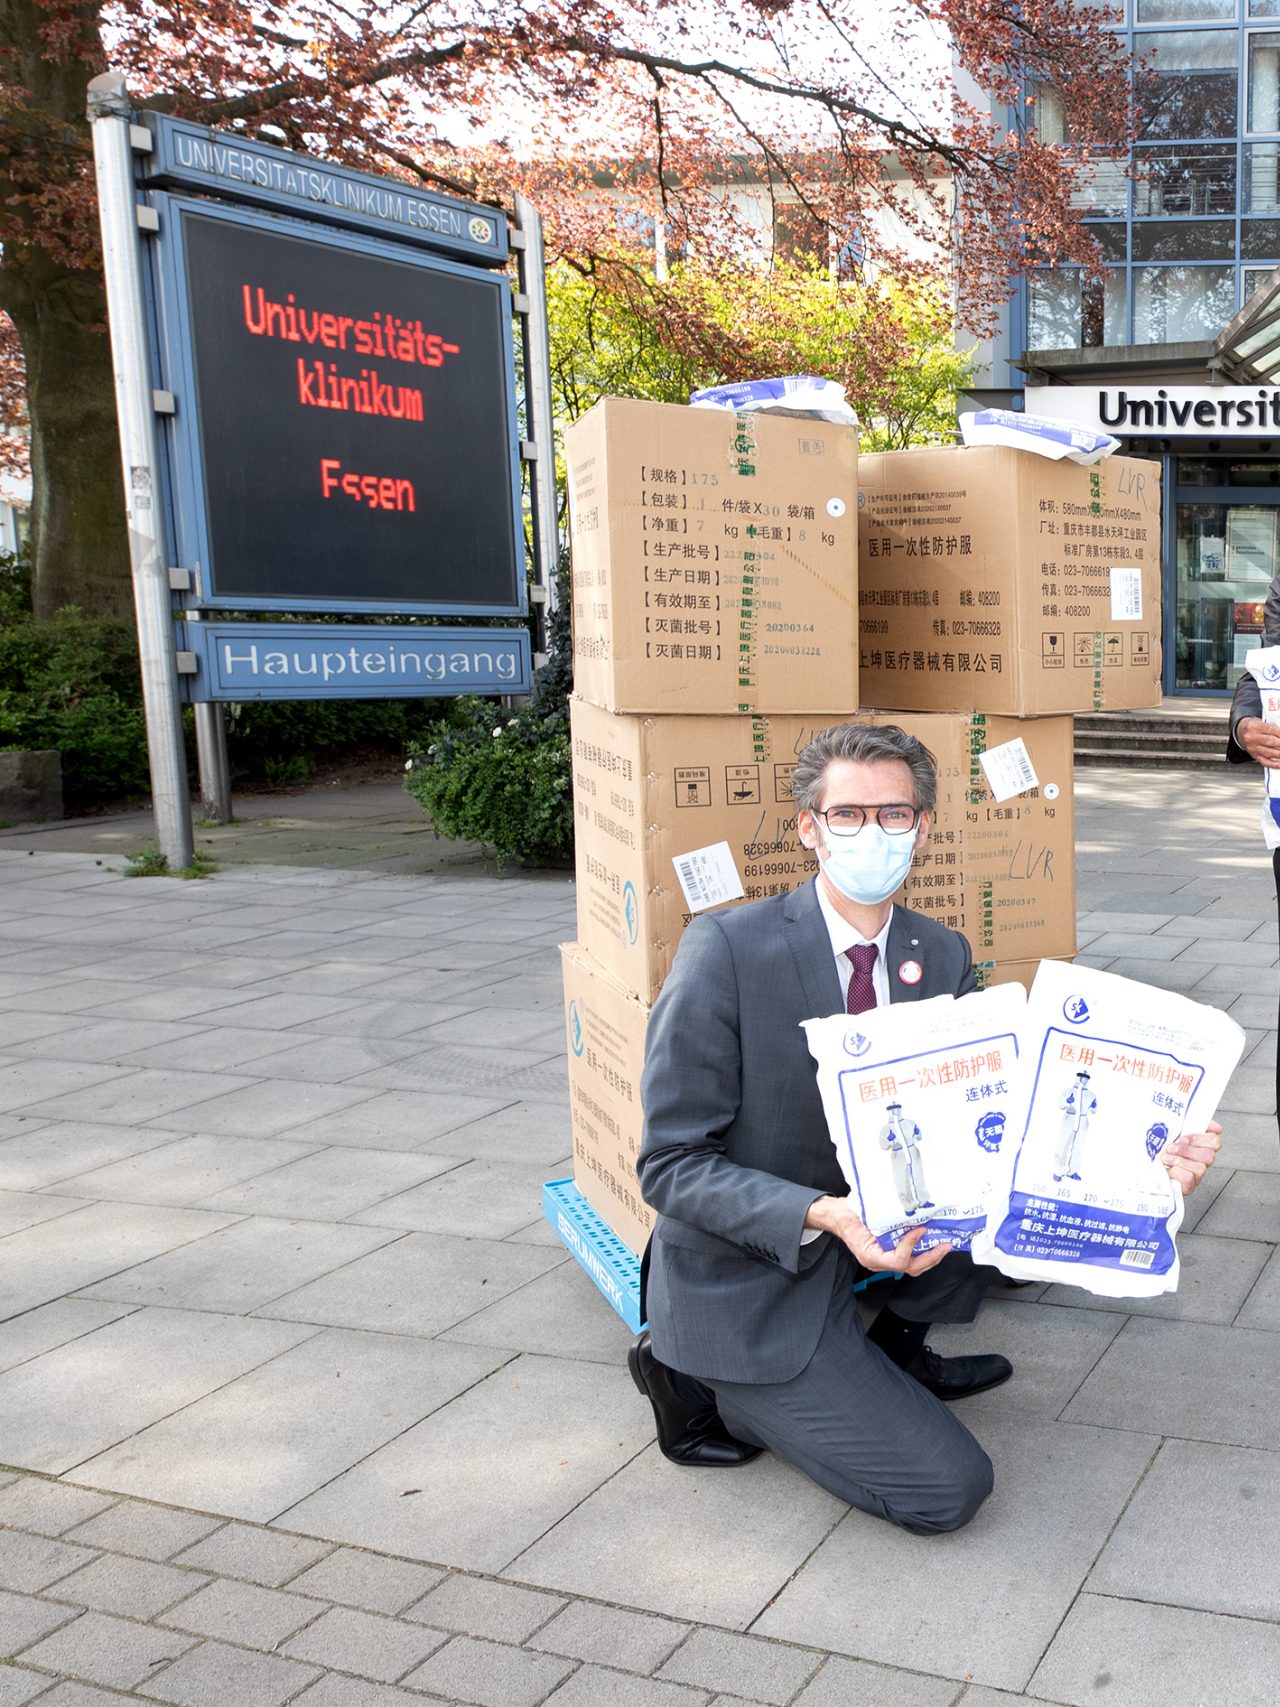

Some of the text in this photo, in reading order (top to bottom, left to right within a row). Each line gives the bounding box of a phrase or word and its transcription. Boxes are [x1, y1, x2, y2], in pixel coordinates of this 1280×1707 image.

[407, 200, 461, 235] ESSEN
[243, 284, 460, 367] Universitäts-
[298, 357, 424, 421] klinikum
[724, 523, 739, 539] kg
[821, 532, 835, 546] kg
[869, 535, 972, 557] 医用一次性防护服
[224, 644, 516, 682] Haupteingang
[966, 811, 978, 823] kg
[1044, 807, 1055, 818] kg
[859, 1050, 1004, 1103] 医用一次性防护服
[1060, 1043, 1195, 1095] 医用一次性防护服
[965, 1080, 1008, 1103] 连体式
[1152, 1090, 1186, 1116] 连体式
[970, 1205, 984, 1215] 175
[1020, 1219, 1160, 1251] 重庆上坤医疗器械有限公司
[557, 1211, 625, 1313] SERUMWERK
